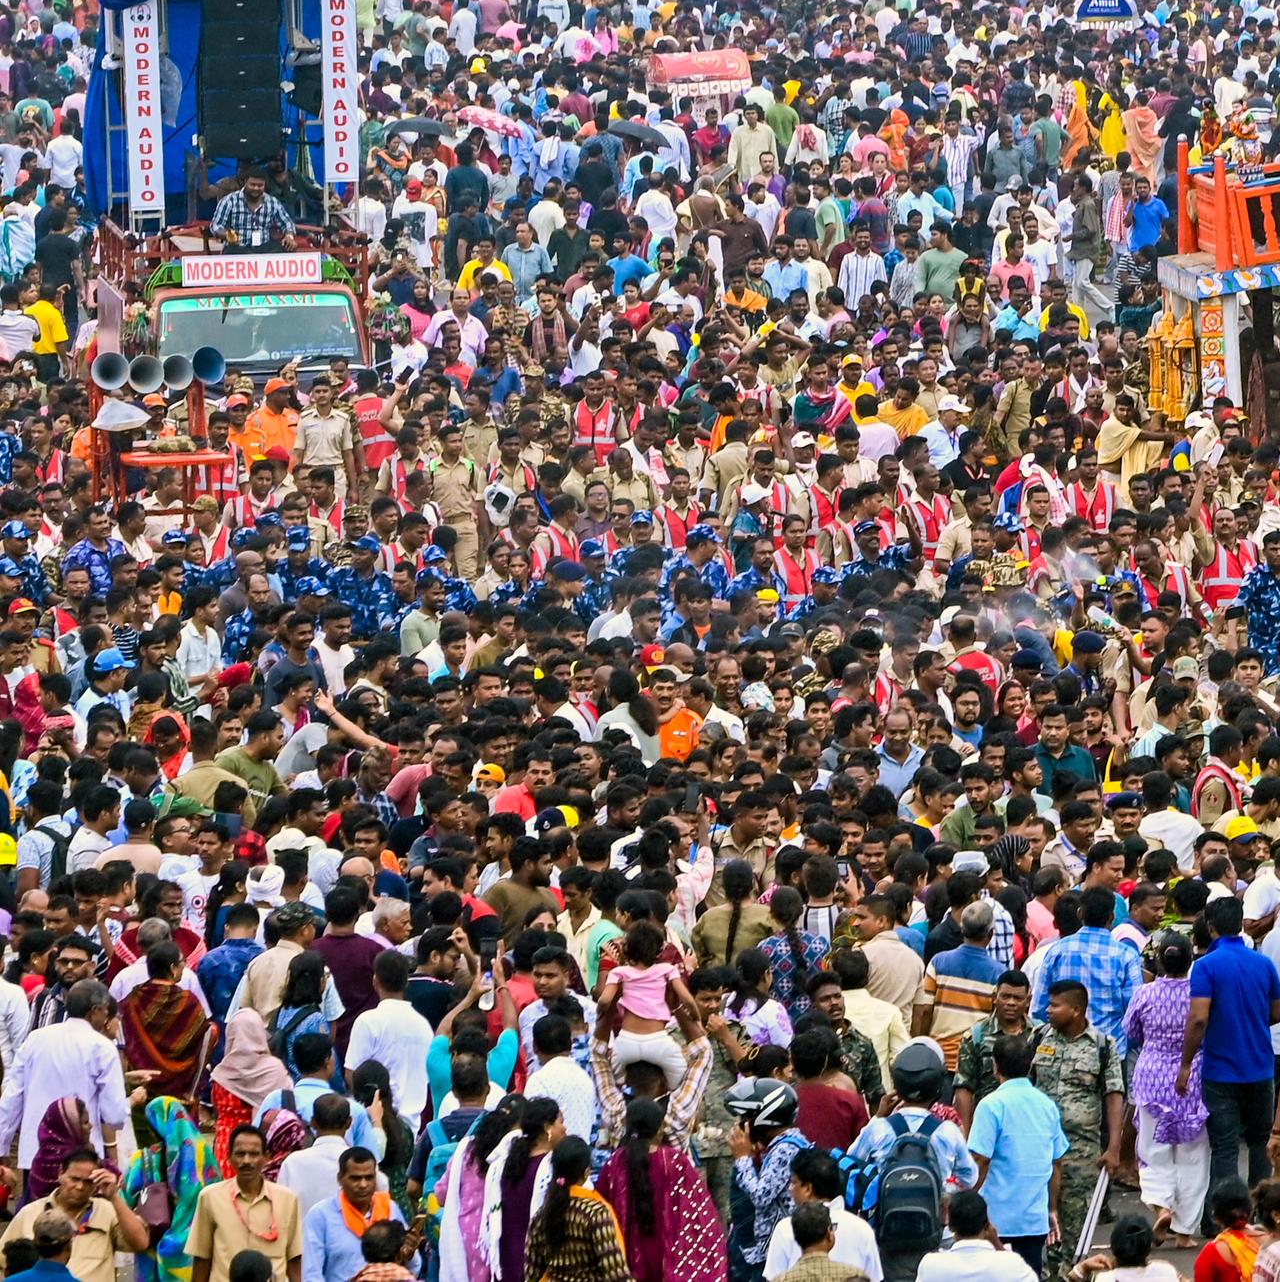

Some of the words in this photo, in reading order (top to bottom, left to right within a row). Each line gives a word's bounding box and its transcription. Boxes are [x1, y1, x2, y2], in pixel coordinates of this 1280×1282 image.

[133, 26, 152, 118] MODERN
[329, 0, 347, 89] MODERN
[138, 126, 157, 203] AUDIO
[333, 98, 350, 174] AUDIO
[187, 260, 258, 282] MODERN
[264, 258, 317, 279] AUDIO
[196, 297, 241, 308] MAA
[249, 294, 316, 307] LAXMI
